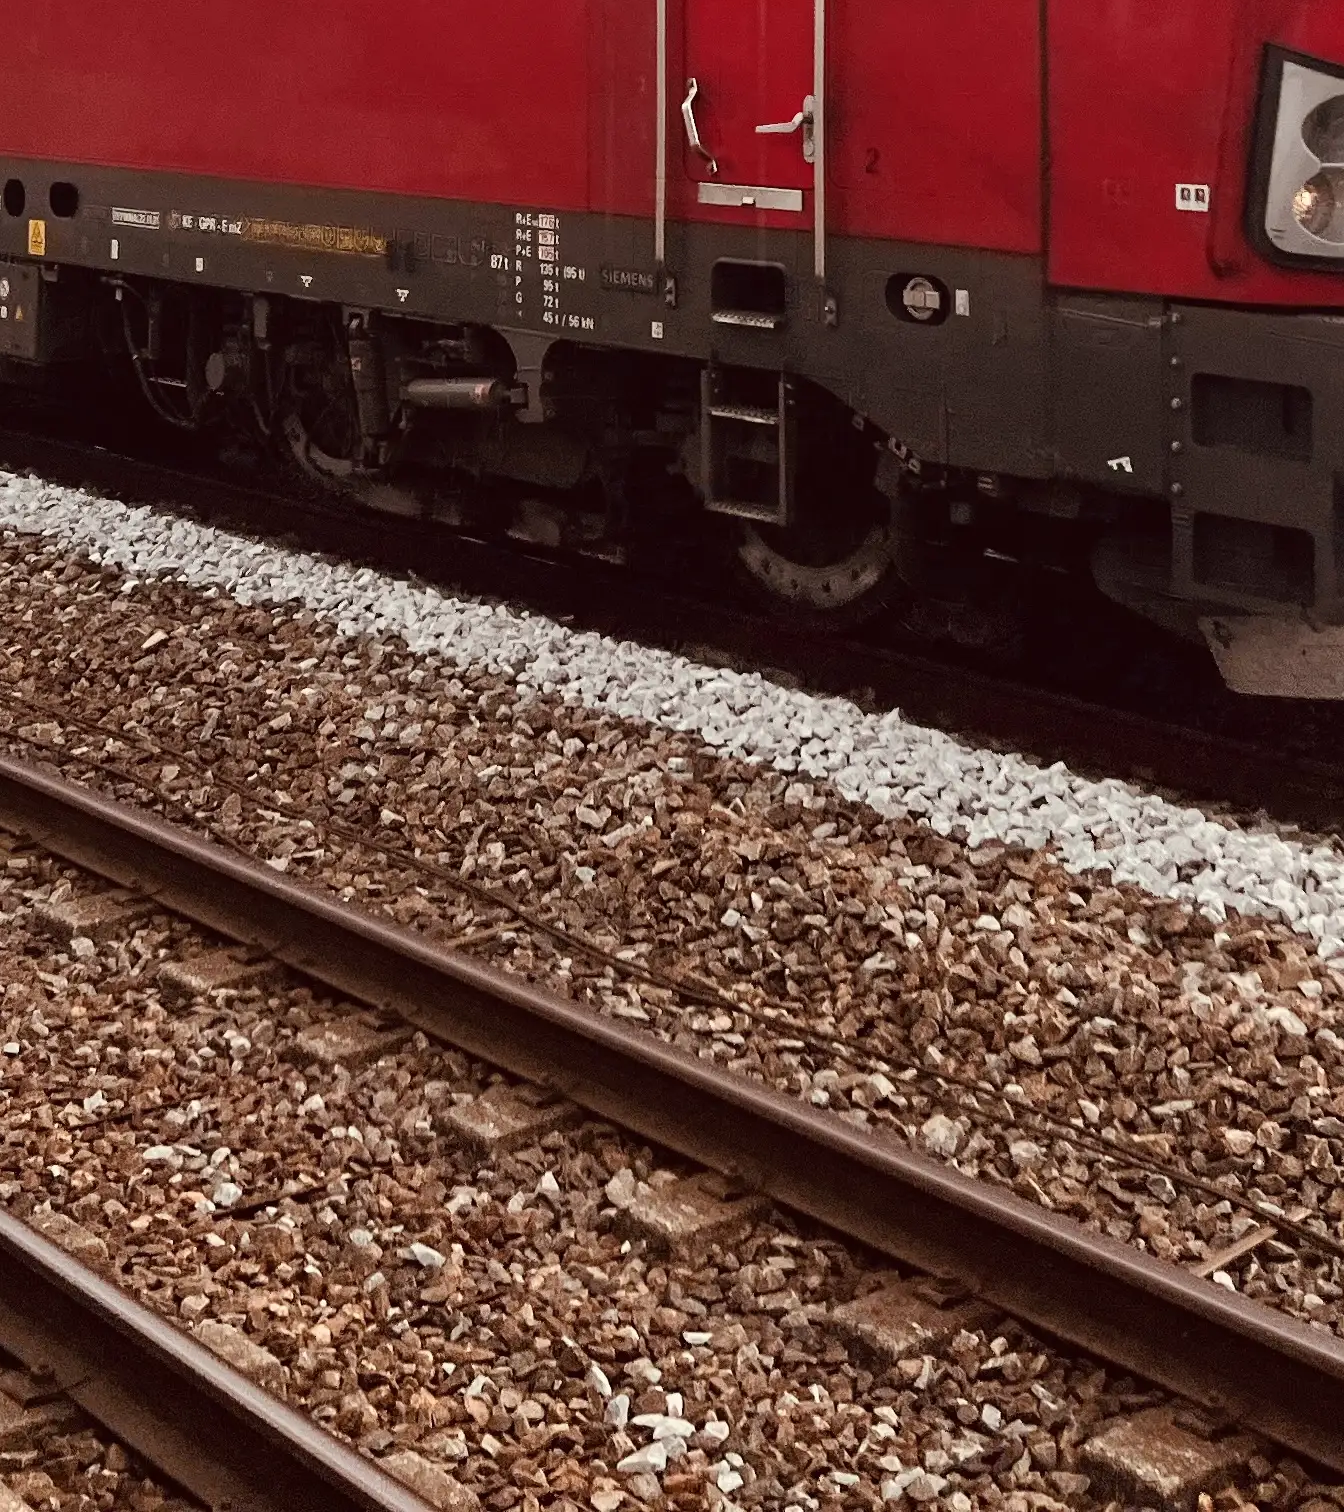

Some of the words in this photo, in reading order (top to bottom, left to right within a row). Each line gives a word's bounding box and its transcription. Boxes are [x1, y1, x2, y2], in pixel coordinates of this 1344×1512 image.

[866, 147, 881, 174] 2
[490, 254, 503, 269] 87
[515, 259, 523, 272] R
[515, 276, 522, 287] P
[601, 269, 654, 289] SIEMENS
[515, 291, 523, 304] G
[543, 294, 554, 308] 72
